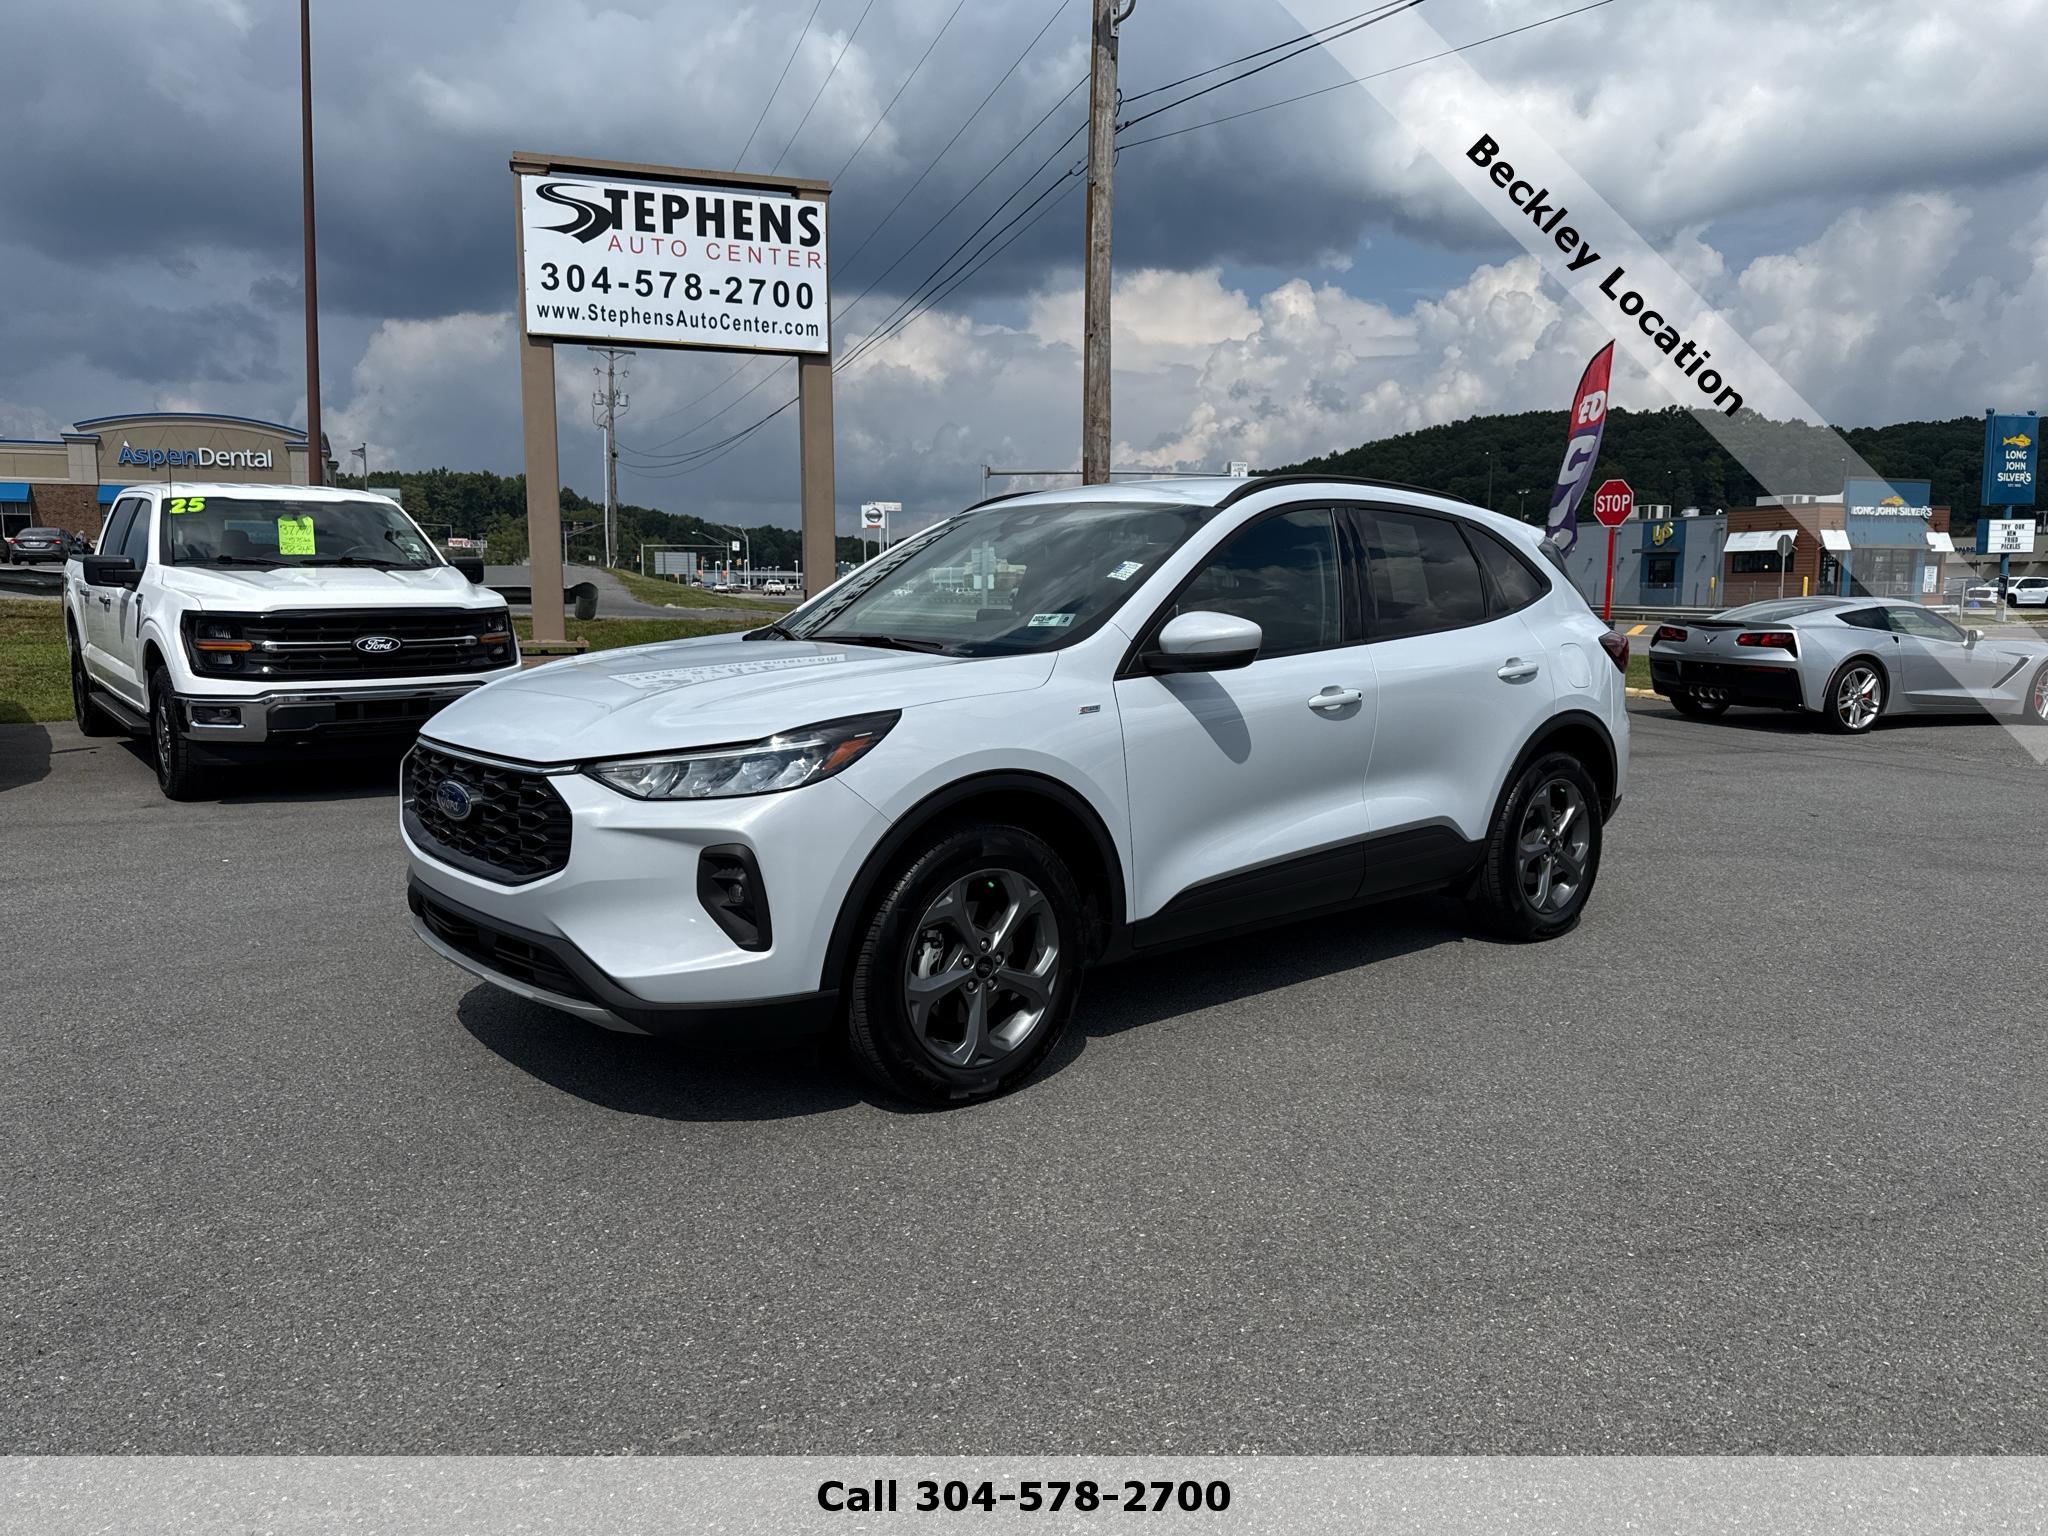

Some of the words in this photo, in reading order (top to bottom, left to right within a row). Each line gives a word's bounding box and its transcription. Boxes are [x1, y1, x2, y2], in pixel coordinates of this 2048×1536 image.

[531, 182, 822, 248] STEPHENS
[608, 235, 688, 257] AUTO
[706, 243, 822, 269] CENTER
[540, 262, 814, 310] 304-578-2700
[536, 303, 820, 337] www.StephensAutoCenter.com
[2005, 450, 2028, 460] LONG
[2005, 461, 2027, 471] JOHN
[1997, 471, 2032, 485] SILVER'S
[169, 497, 206, 514] 25
[1596, 494, 1631, 513] STOP
[1851, 506, 1875, 516] LONG
[1875, 506, 1897, 516] JOHN
[1898, 505, 1933, 519] SILVER'S
[365, 639, 393, 650] Ford
